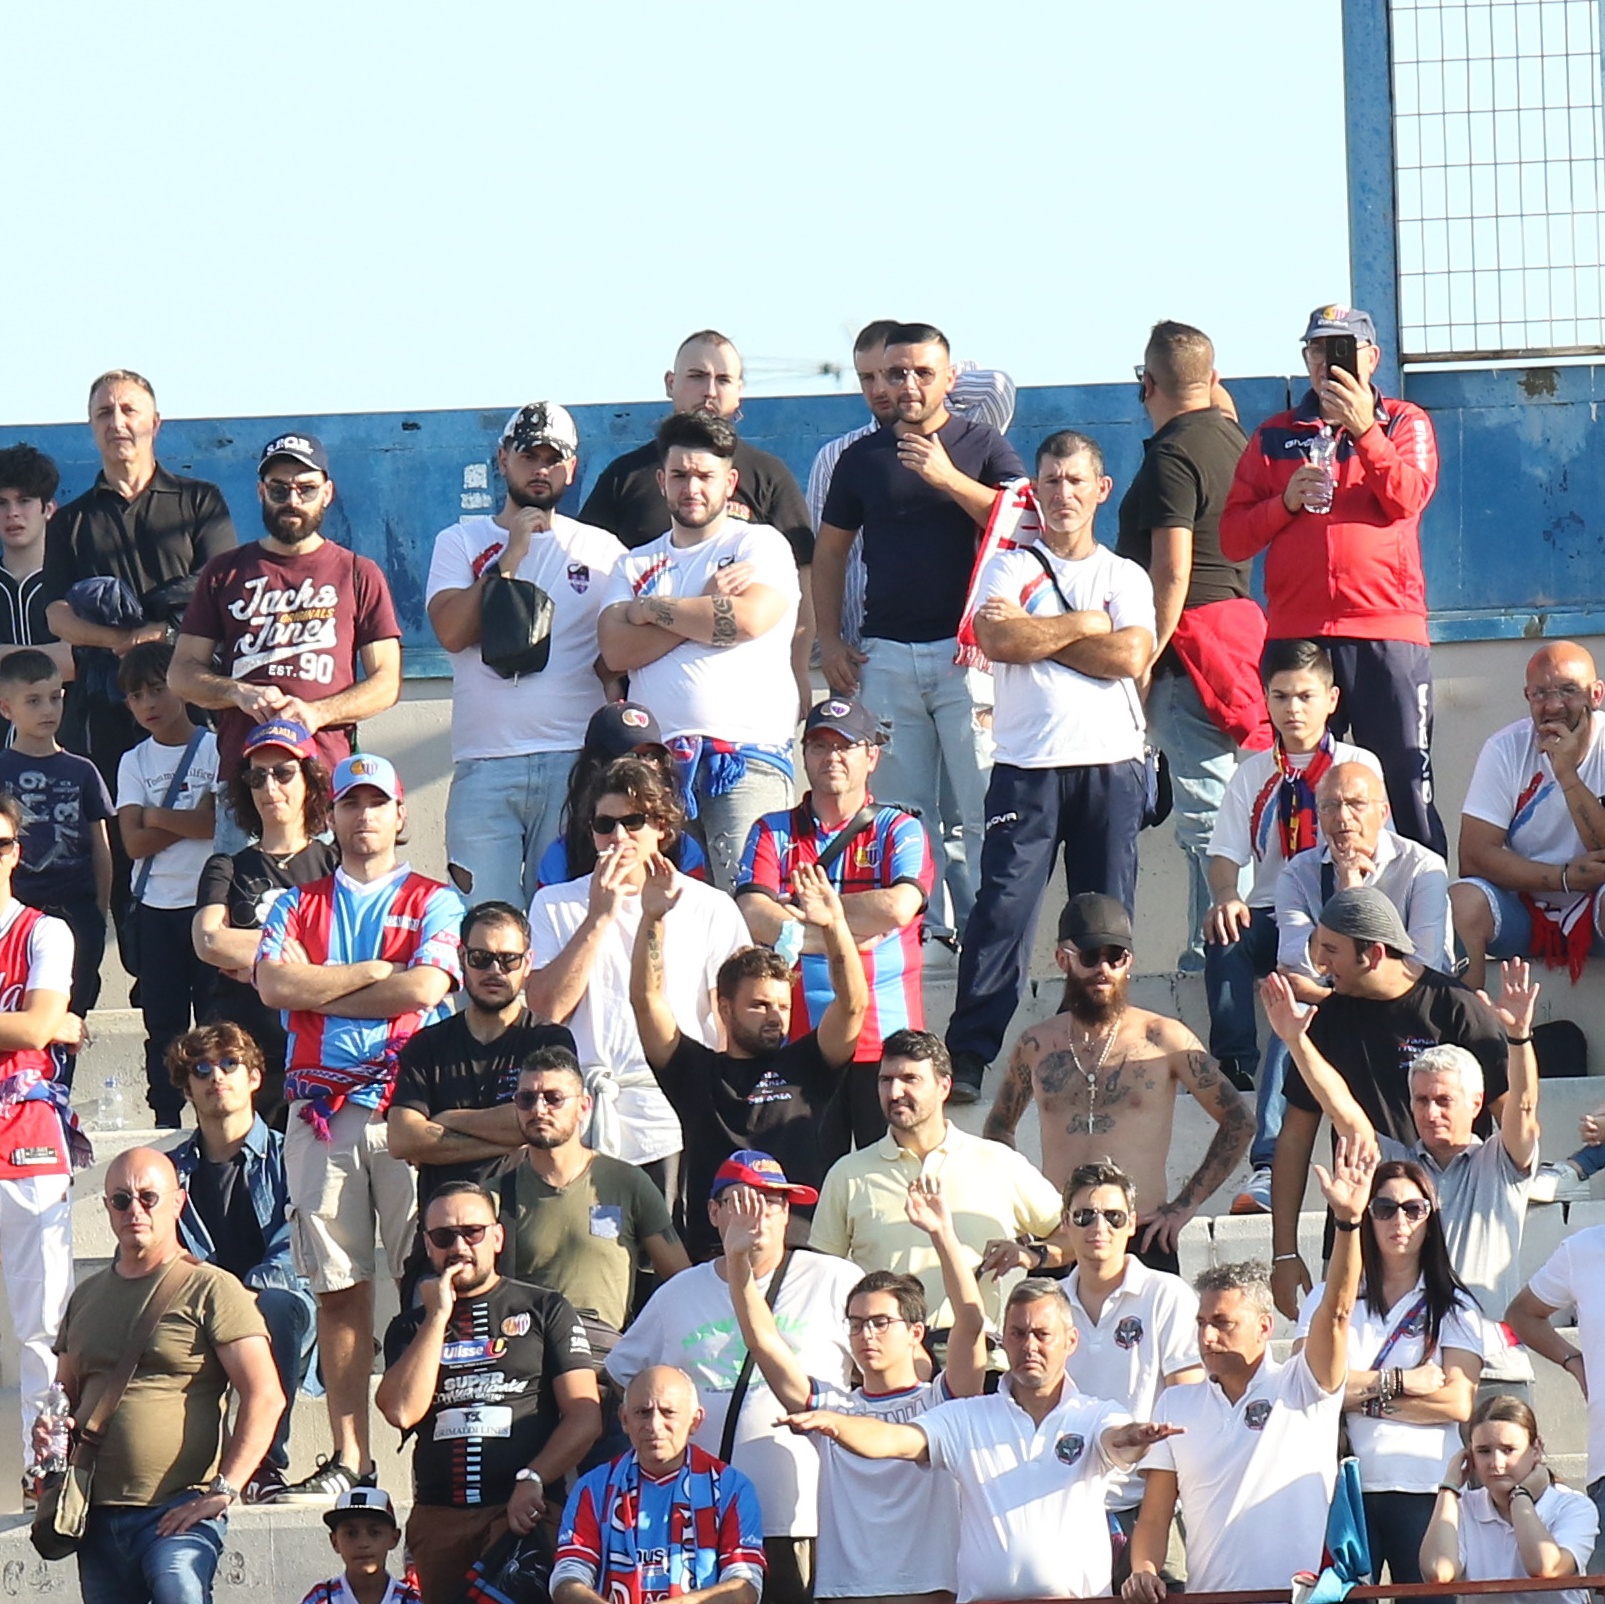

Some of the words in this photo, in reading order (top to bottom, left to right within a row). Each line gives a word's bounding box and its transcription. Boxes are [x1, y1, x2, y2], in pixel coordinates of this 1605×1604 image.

[279, 608, 336, 623] ORIGINALS
[234, 617, 337, 656] Jones
[268, 664, 296, 677] EST.
[299, 653, 335, 684] 90
[444, 1344, 484, 1360] Ulisse
[444, 1372, 506, 1392] SUPER
[479, 1423, 511, 1436] LINES
